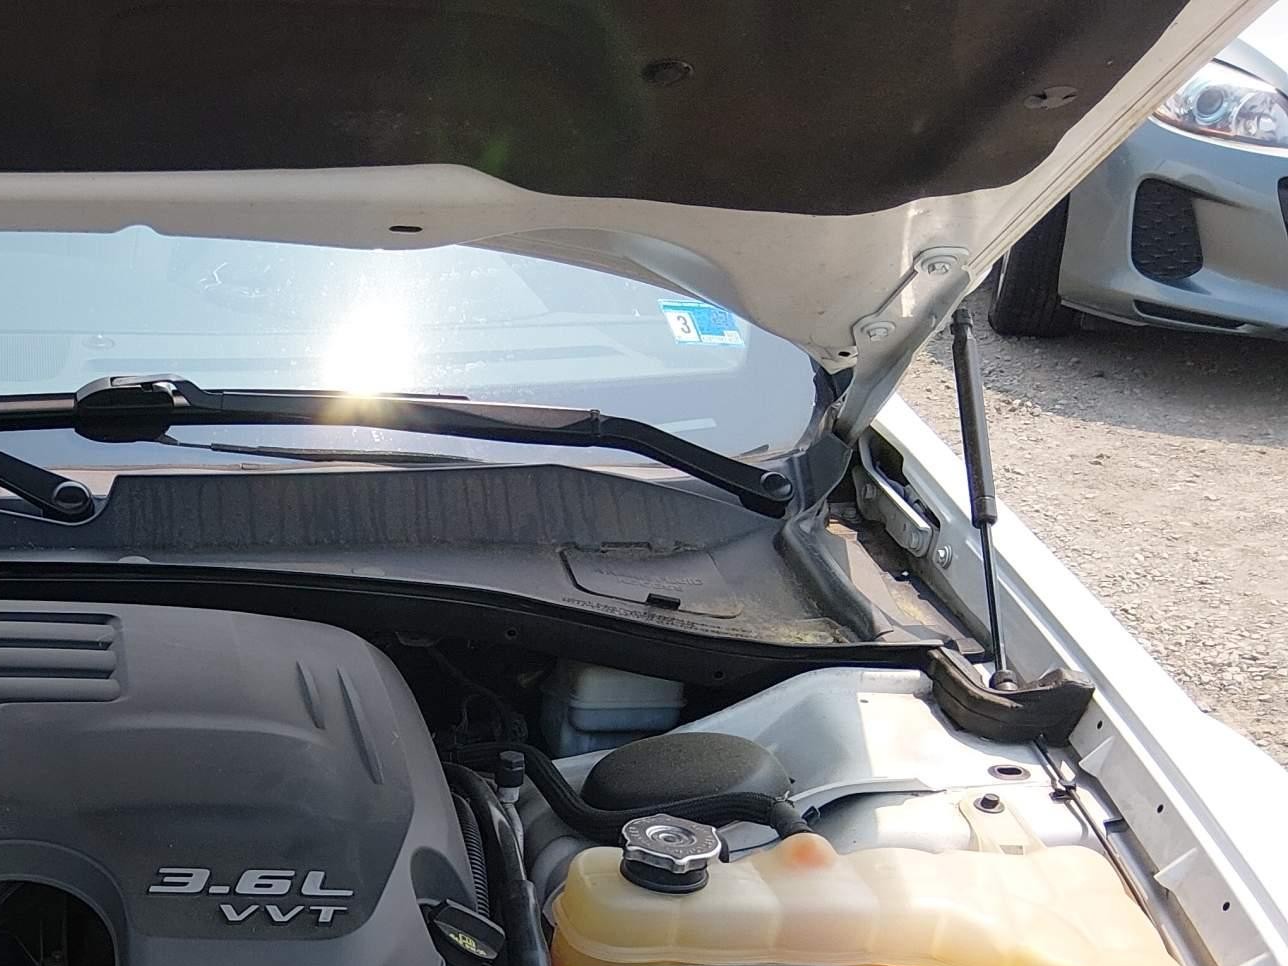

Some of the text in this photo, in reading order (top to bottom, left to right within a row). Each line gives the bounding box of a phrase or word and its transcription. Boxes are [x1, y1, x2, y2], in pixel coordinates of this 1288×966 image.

[677, 315, 691, 334] 3
[148, 867, 354, 896] 3.6L
[219, 904, 348, 923] VVT
